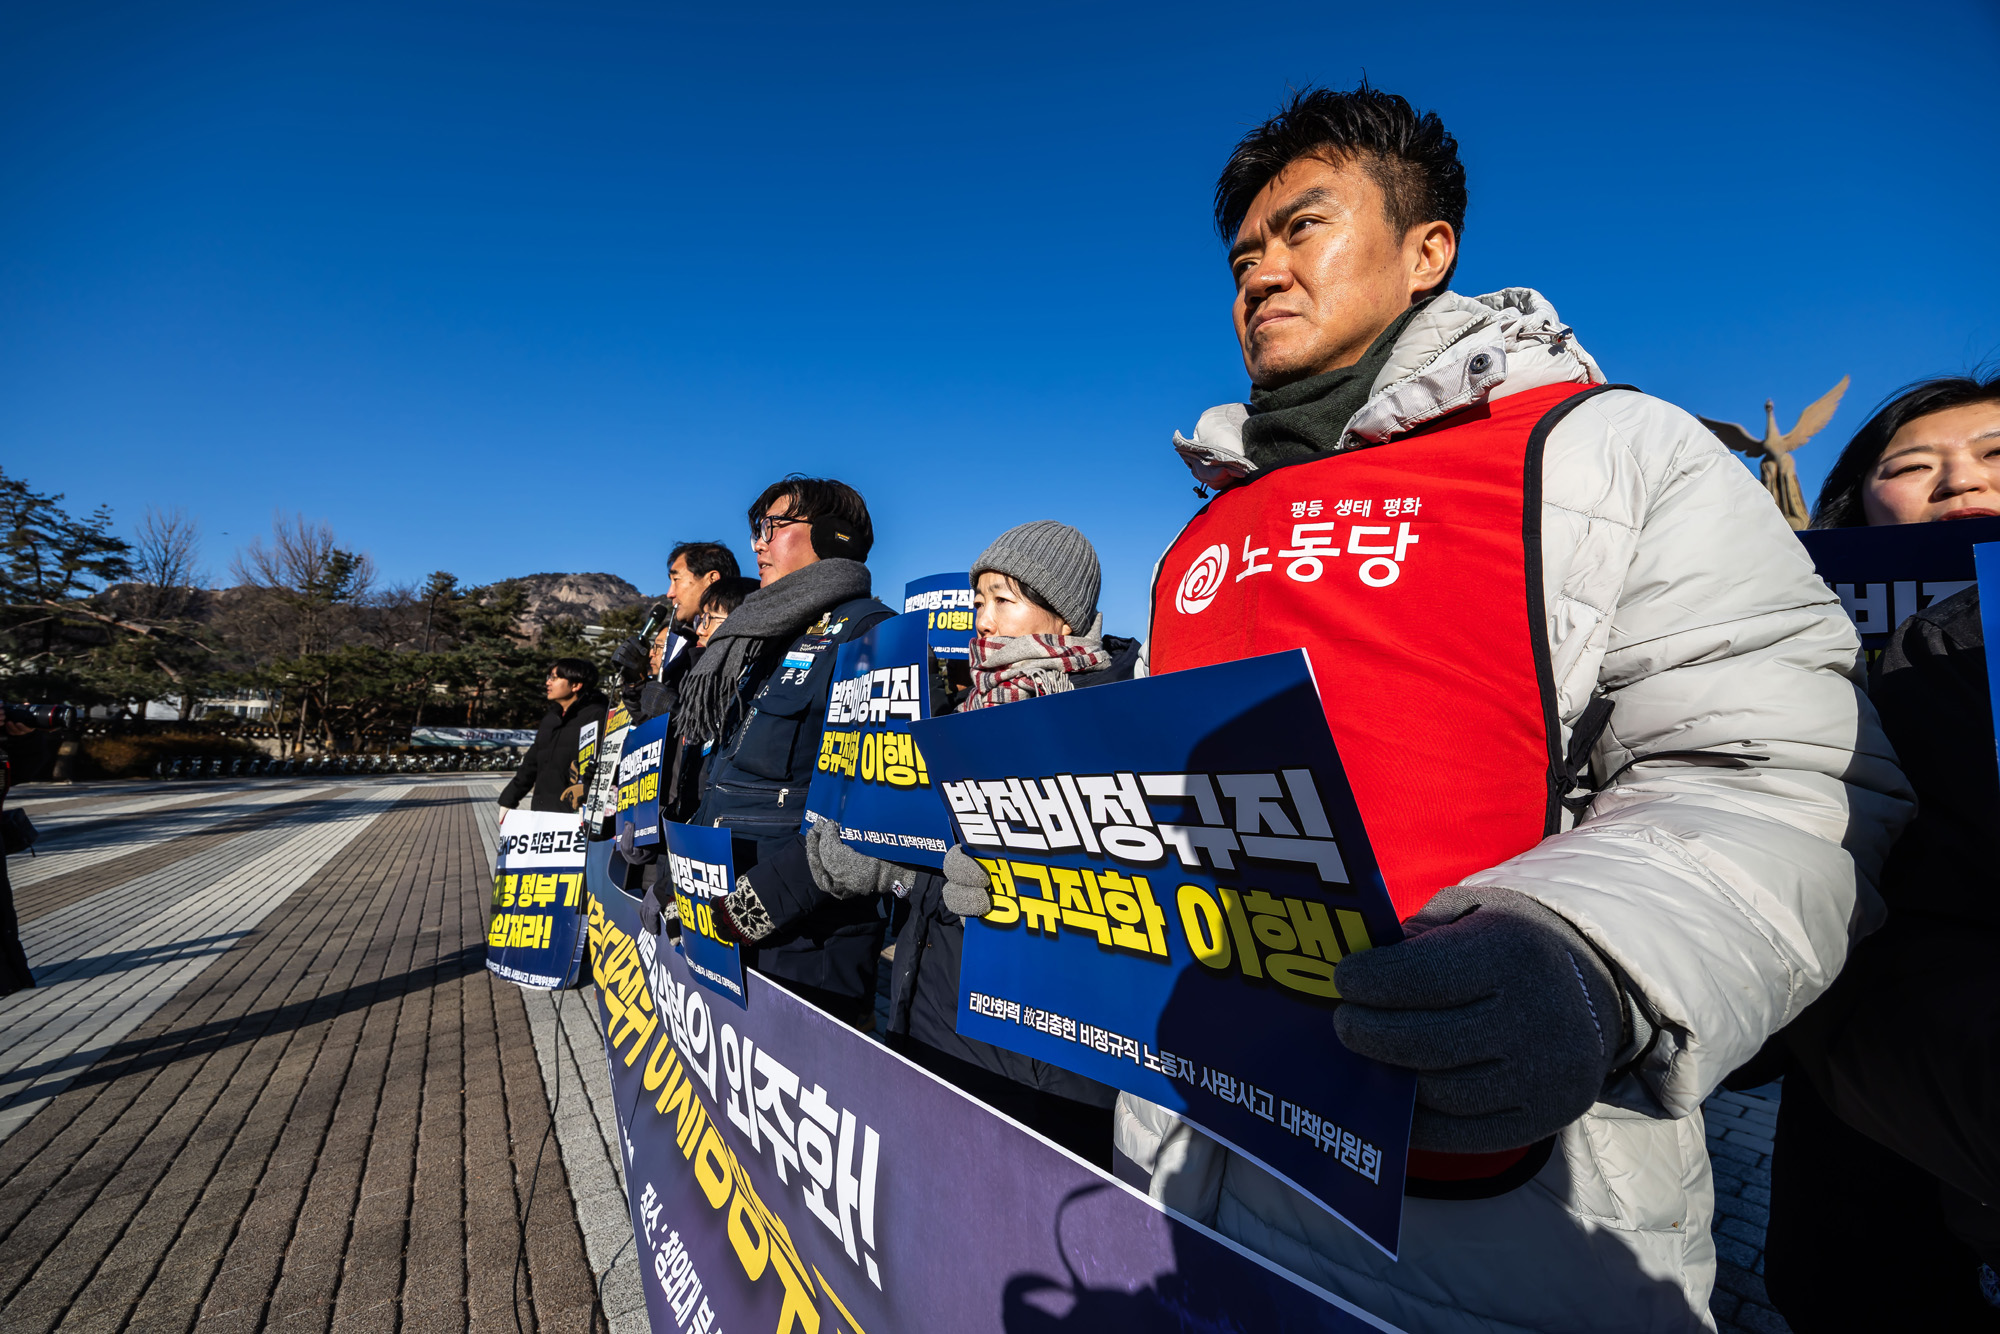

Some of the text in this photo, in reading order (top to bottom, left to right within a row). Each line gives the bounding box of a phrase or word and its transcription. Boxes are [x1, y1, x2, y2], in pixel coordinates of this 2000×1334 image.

[1291, 497, 1422, 518] 평등 생태 평화
[1235, 522, 1419, 588] 노동당
[937, 610, 974, 630] 이행!
[827, 664, 921, 723] 발전비정규직
[861, 731, 930, 786] 이행!
[530, 831, 587, 854] 직접고용
[864, 831, 898, 846] 사망사고
[898, 834, 947, 853] 대책위원회
[942, 768, 1350, 884] 발전비정규직
[974, 858, 1168, 957] 정규직화
[969, 992, 1383, 1185] 태안화력 故김충현 비정규직 노동자 사망사고 대책위원회
[720, 1023, 883, 1292] 외주화!
